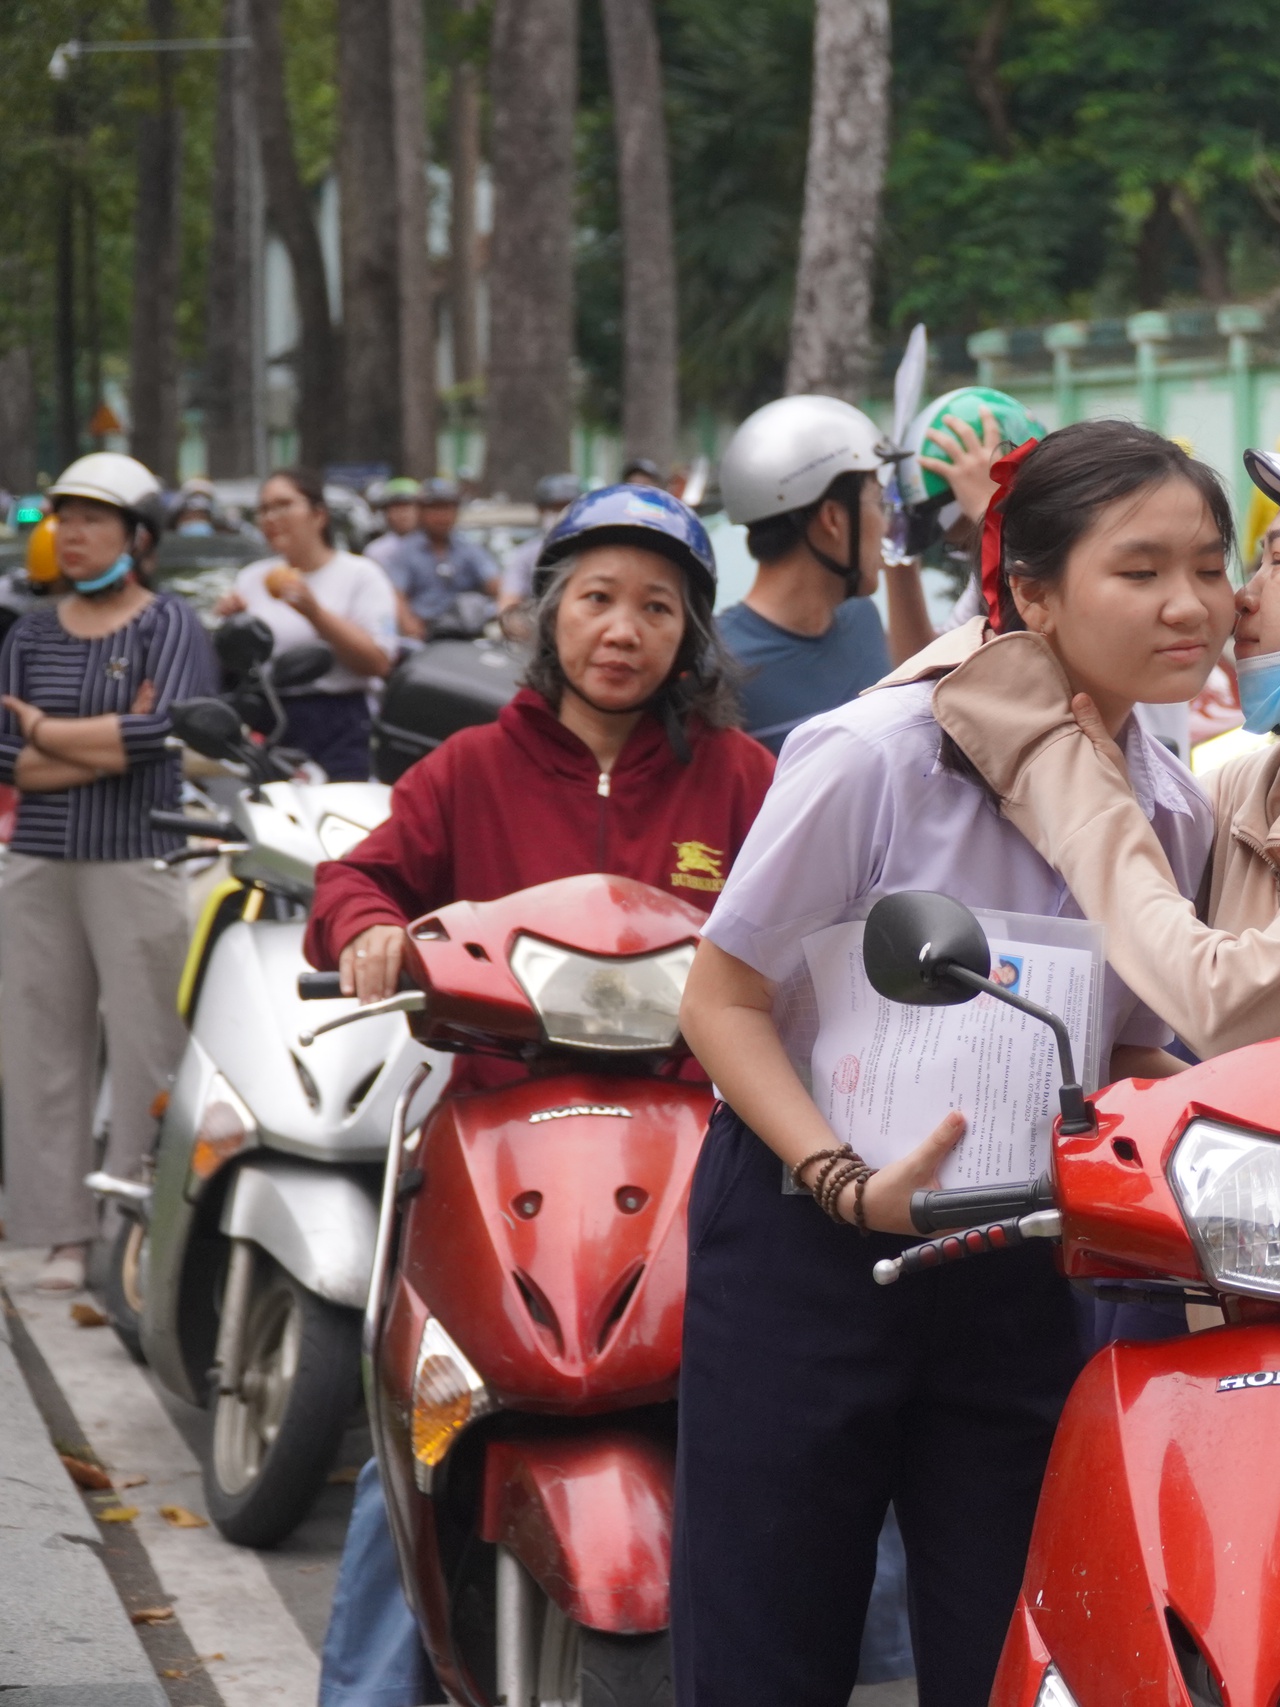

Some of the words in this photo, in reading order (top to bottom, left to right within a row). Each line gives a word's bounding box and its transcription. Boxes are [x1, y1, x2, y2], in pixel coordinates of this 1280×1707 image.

[1039, 1049, 1046, 1058] 10
[1032, 1078, 1042, 1091] học
[1044, 1071, 1052, 1090] BÁO
[1024, 1083, 1033, 1121] 07/06/2024
[1041, 1091, 1049, 1117] DANH
[1029, 1144, 1037, 1157] học
